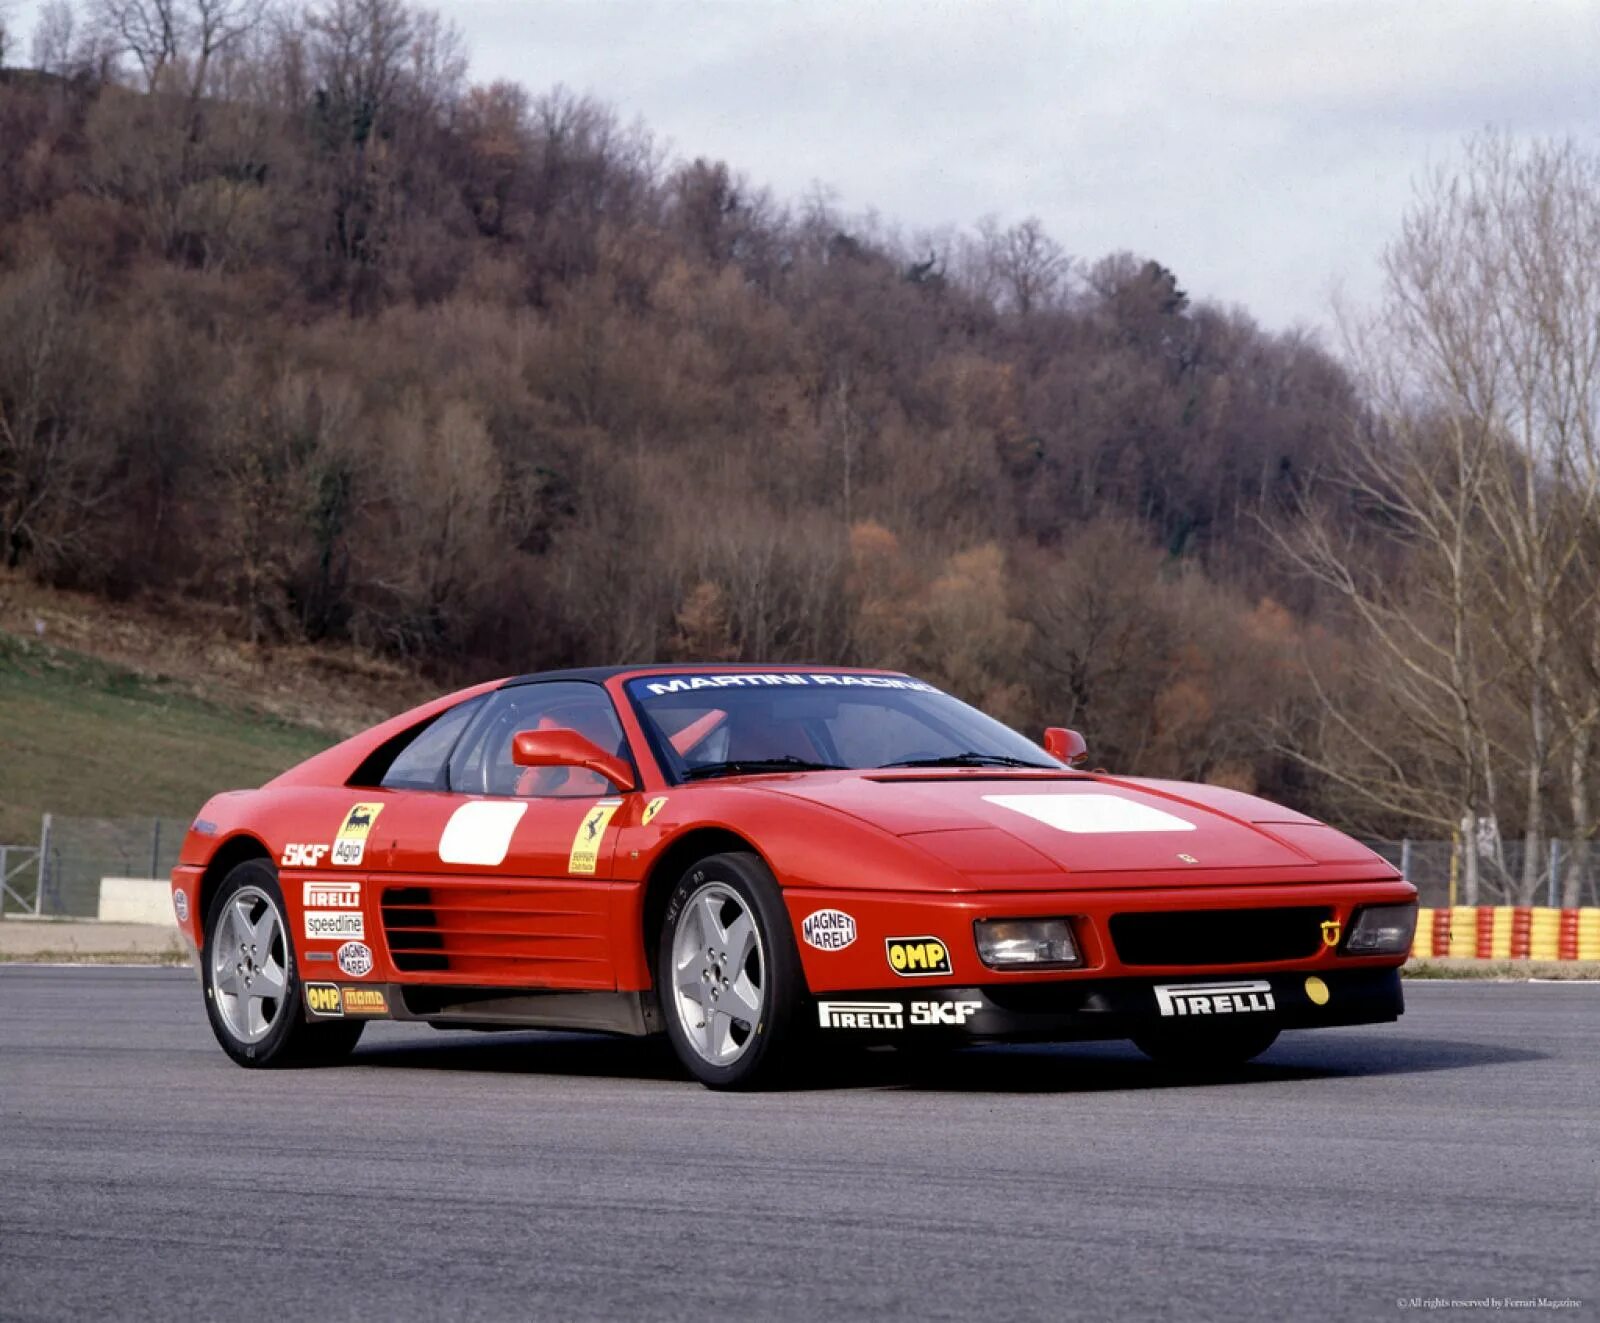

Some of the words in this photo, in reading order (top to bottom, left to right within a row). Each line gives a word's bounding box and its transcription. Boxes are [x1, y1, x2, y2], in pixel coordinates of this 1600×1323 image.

[648, 673, 807, 695] MARTINI
[809, 673, 944, 695] RACING
[281, 843, 329, 866] SKF
[335, 841, 360, 862] Agip
[303, 882, 361, 907] PIRELLI
[307, 914, 362, 937] speedline
[345, 991, 384, 1005] momo
[1153, 980, 1276, 1017] PIRELLI
[817, 1001, 904, 1029] PIRELLI
[909, 1000, 982, 1026] SKF
